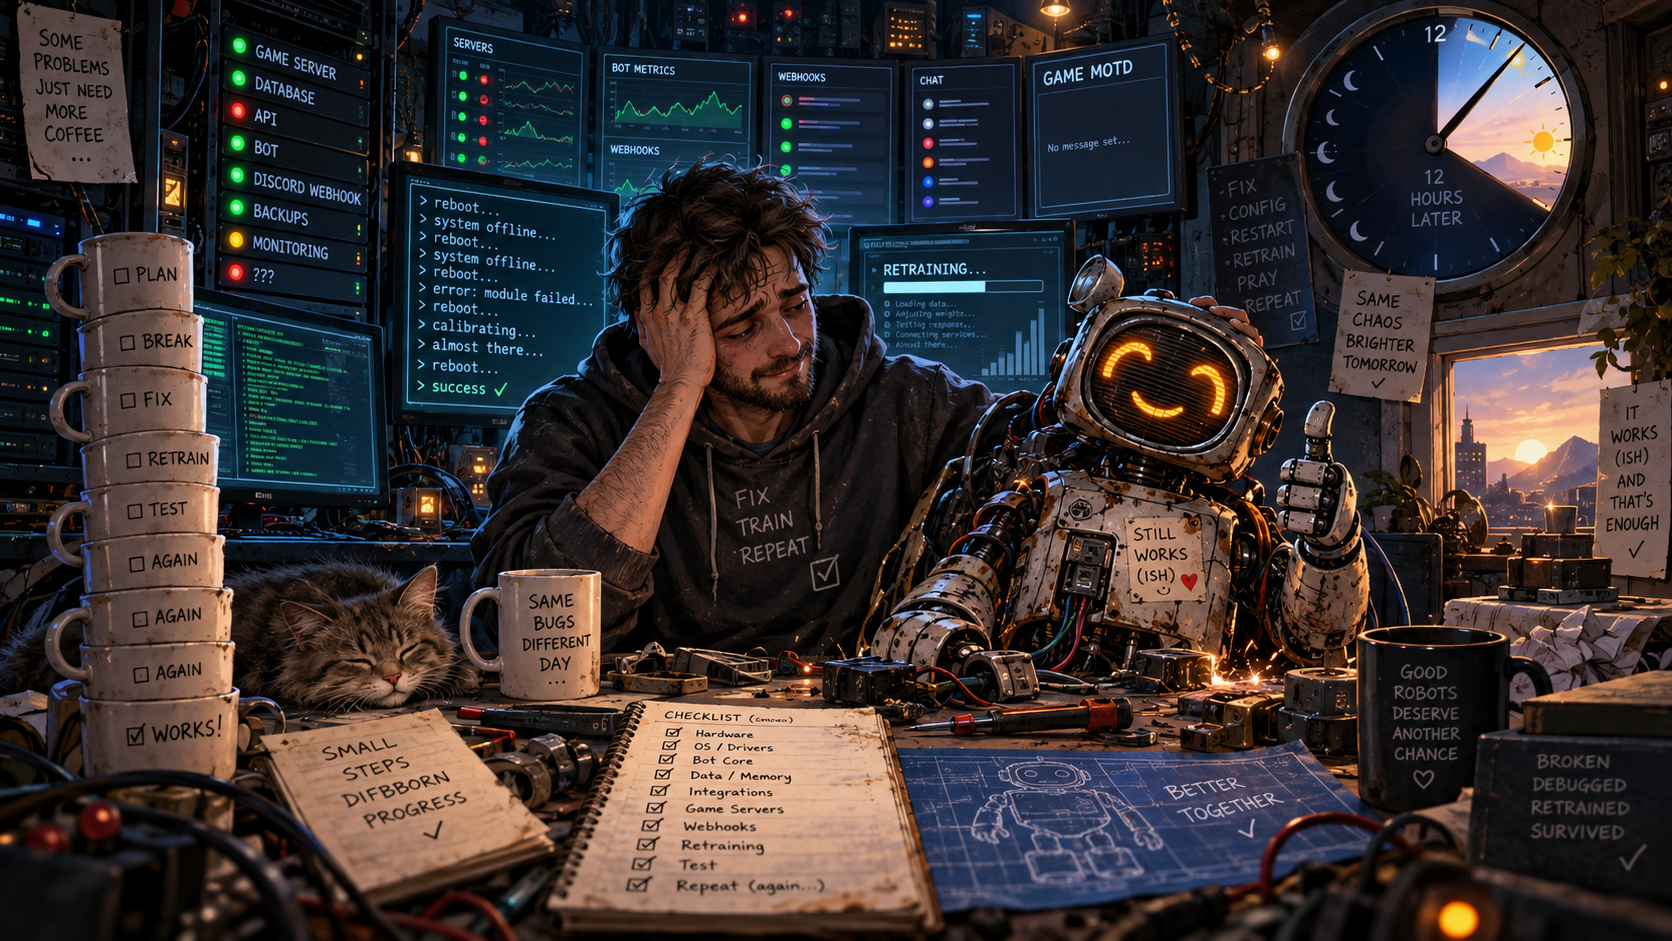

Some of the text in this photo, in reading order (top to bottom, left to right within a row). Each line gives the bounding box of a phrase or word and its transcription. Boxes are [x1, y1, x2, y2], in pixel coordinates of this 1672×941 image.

[39, 29, 83, 50] SOME
[1424, 24, 1446, 43] 12
[454, 37, 493, 54] SERVERS
[33, 53, 109, 76] PROBLEMS
[256, 44, 336, 80] GAME SERVER
[612, 63, 675, 75] BOT METRICS
[778, 72, 826, 82] WEBHOOKS
[920, 76, 944, 85] CHAT
[1043, 60, 1133, 86] GAME MOTD
[35, 79, 112, 99] JUST NEED
[256, 77, 314, 105] DATABASE
[46, 104, 87, 120] MORE
[254, 110, 277, 127] API
[45, 126, 103, 143] COFFEE
[254, 141, 278, 158] BOT
[611, 145, 659, 155] WEBHOOKS
[1048, 136, 1130, 152] No message set...
[1424, 169, 1444, 185] 12
[254, 172, 361, 205] DISCORD WEBHOOK
[1228, 178, 1257, 198] FIX
[1411, 190, 1463, 206] HOURS
[254, 204, 308, 226] BACKUPS
[435, 198, 499, 216] reboot...
[1229, 197, 1286, 221] CONFIG
[434, 215, 480, 231] system
[487, 222, 556, 240] offline...
[1411, 211, 1463, 228] LATER
[1230, 219, 1294, 245] RESTART
[253, 237, 329, 260] MONITORING
[434, 233, 498, 249] reboot...
[434, 250, 479, 264] system
[486, 255, 555, 272] offline...
[1233, 243, 1295, 268] RETRAIN
[136, 267, 177, 283] PLAN
[253, 268, 274, 284] ???
[434, 267, 498, 282] reboot...
[884, 263, 986, 275] RETRAINING...
[1237, 269, 1278, 292] PRAY
[433, 284, 477, 297] error:
[484, 289, 527, 301] module
[534, 291, 593, 306] failed...
[1244, 291, 1301, 314] REPEAT
[1356, 290, 1400, 308] SAME
[433, 301, 498, 316] reboot...
[433, 319, 536, 340] calibrating...
[1352, 313, 1402, 330] CHAOS
[142, 333, 193, 349] BREAK
[433, 338, 478, 353] almost
[487, 344, 543, 357] there...
[1346, 334, 1415, 352] BRIGHTER
[433, 360, 498, 374] reboot...
[1343, 355, 1418, 373] TOMORROW
[433, 382, 486, 394] success
[144, 392, 172, 407] FIX
[1626, 405, 1639, 421] IT
[1611, 425, 1658, 444] WORKS
[148, 451, 209, 466] RETRAIN
[1615, 447, 1648, 467] (ISH)
[1617, 473, 1645, 489] AND
[735, 487, 770, 509] FIX
[1610, 492, 1653, 510] THAT'S
[149, 502, 188, 517] TEST
[735, 510, 793, 536] TRAIN
[1606, 515, 1659, 532] ENOUGH
[1134, 528, 1176, 541] STILL
[739, 536, 809, 564] REPEAT
[1134, 548, 1188, 562] WORKS
[152, 552, 197, 570] AGAIN
[1137, 567, 1175, 585] (ISH)
[529, 593, 574, 609] SAME
[155, 607, 201, 624] AGAIN
[534, 615, 575, 631] BUGS
[522, 634, 591, 652] DIFFERENT
[156, 662, 201, 681] AGAIN
[539, 656, 571, 672] DAY
[1401, 664, 1447, 680] GOOD
[1394, 686, 1457, 700] ROBOTS
[664, 711, 742, 722] CHECKLIST
[1393, 707, 1459, 720] DESERVE
[152, 714, 222, 742] WORKS!
[696, 730, 754, 739] Hardware
[1393, 727, 1461, 741] ANOTHER
[322, 737, 398, 761] SMALL
[694, 743, 711, 751] OS
[728, 743, 773, 752] Drivers
[1395, 747, 1458, 761] CHANCE
[342, 756, 409, 782] STEPS
[693, 756, 753, 765] Bot Core
[1537, 754, 1609, 769] BROKEN
[691, 771, 722, 780] Data
[741, 772, 791, 784] Memory
[1533, 777, 1627, 794] DEBUGGED
[689, 787, 773, 800] Integrations
[1163, 777, 1246, 800] BETTER
[363, 791, 467, 829] PROGRESS
[686, 804, 784, 814] Game Servers
[1177, 793, 1284, 823] TOGETHER
[1531, 800, 1630, 816] RETRAINED
[683, 822, 756, 832] Webhooks
[1531, 823, 1625, 840] SURVIVED
[682, 839, 764, 855] Retraining
[679, 859, 717, 871] Test
[676, 879, 825, 895] Repeat (again...)
